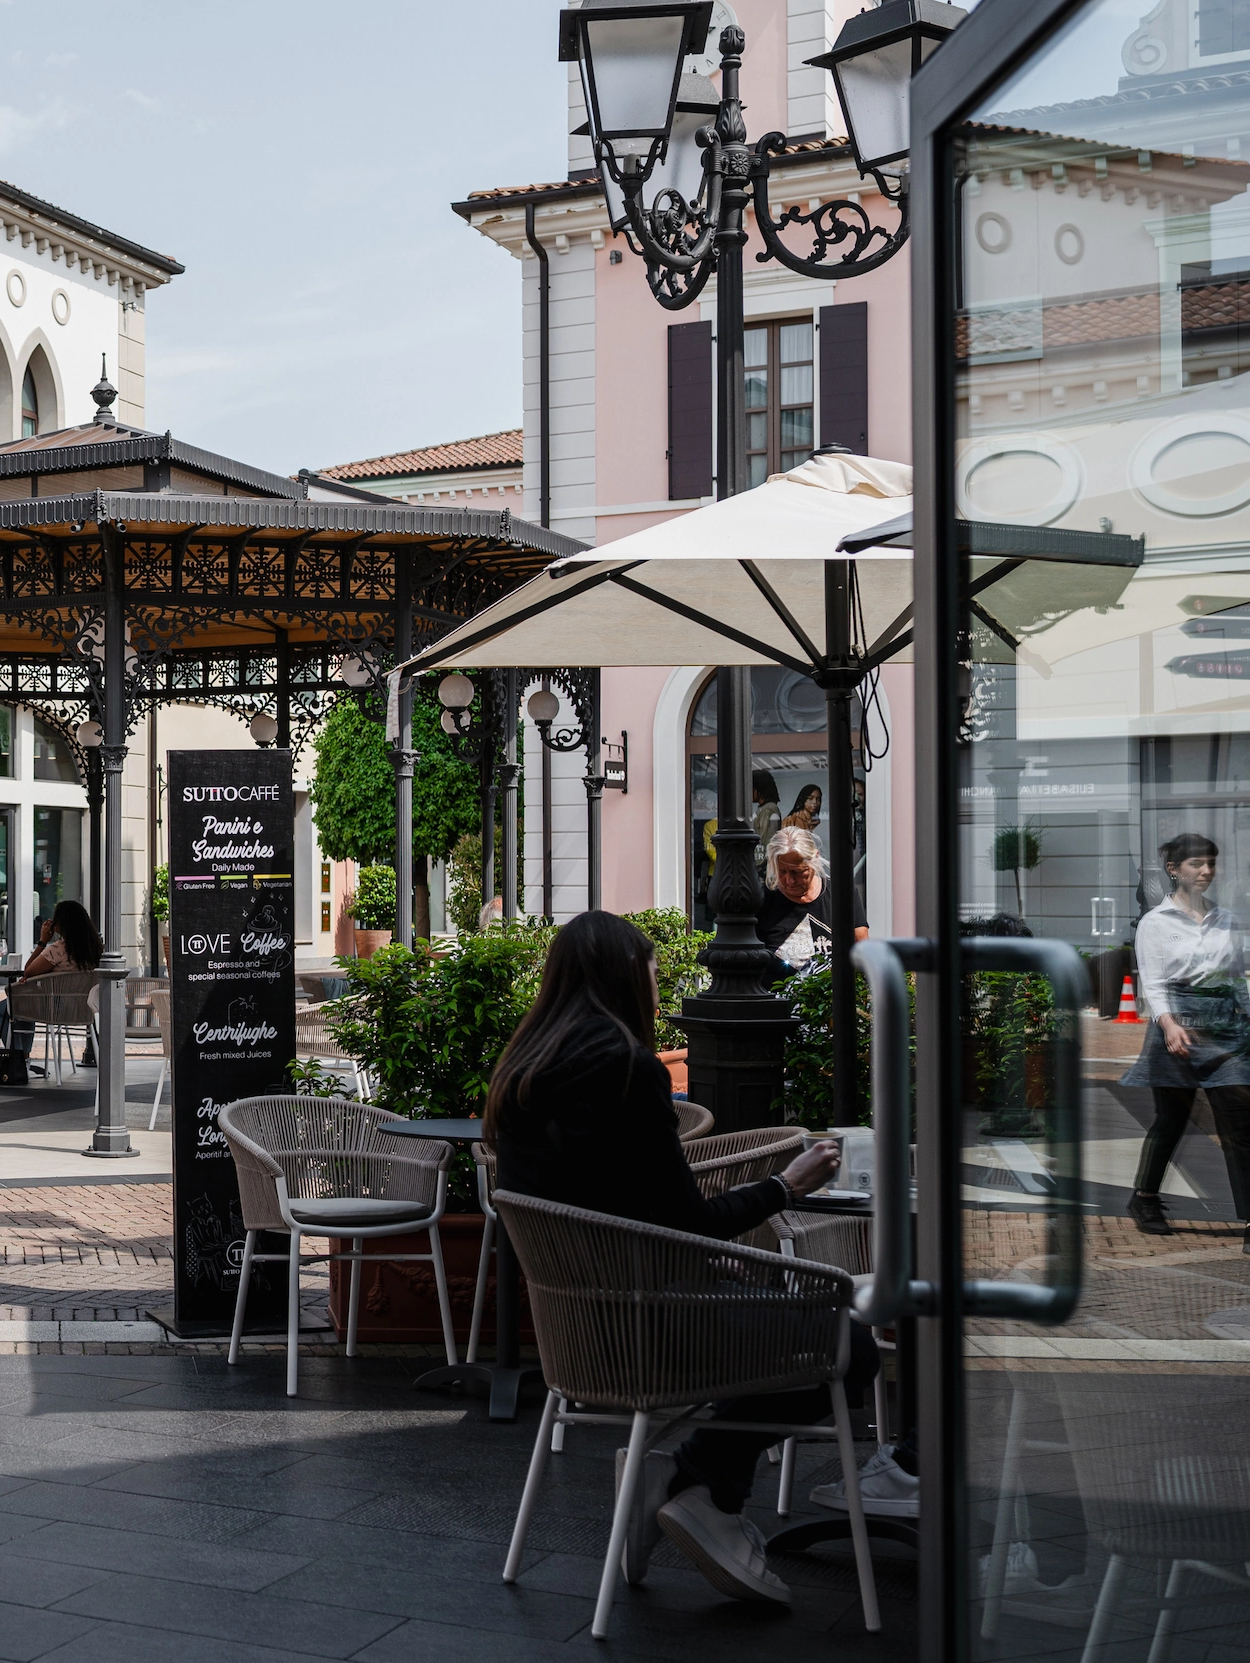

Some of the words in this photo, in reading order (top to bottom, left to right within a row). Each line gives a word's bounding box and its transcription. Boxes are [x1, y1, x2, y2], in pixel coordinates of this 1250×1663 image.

[201, 815, 252, 838] Panini
[252, 822, 264, 834] e
[191, 839, 275, 863] Sandwiches
[211, 863, 231, 873] Daily
[232, 862, 255, 872] Made
[202, 882, 216, 890] Free
[230, 882, 248, 890] Vegan
[262, 881, 293, 890] Vegetarian
[240, 931, 287, 956] Coffee
[207, 960, 244, 970] Espresso
[245, 959, 260, 969] and
[188, 972, 216, 982] special
[216, 971, 251, 981] seasonal
[251, 970, 281, 980] coffees
[192, 1020, 278, 1046] Centrifughe
[199, 1051, 221, 1061] Fresh
[222, 1050, 245, 1060] mixed
[246, 1049, 272, 1060] Juices
[195, 1149, 223, 1160] Aperitif
